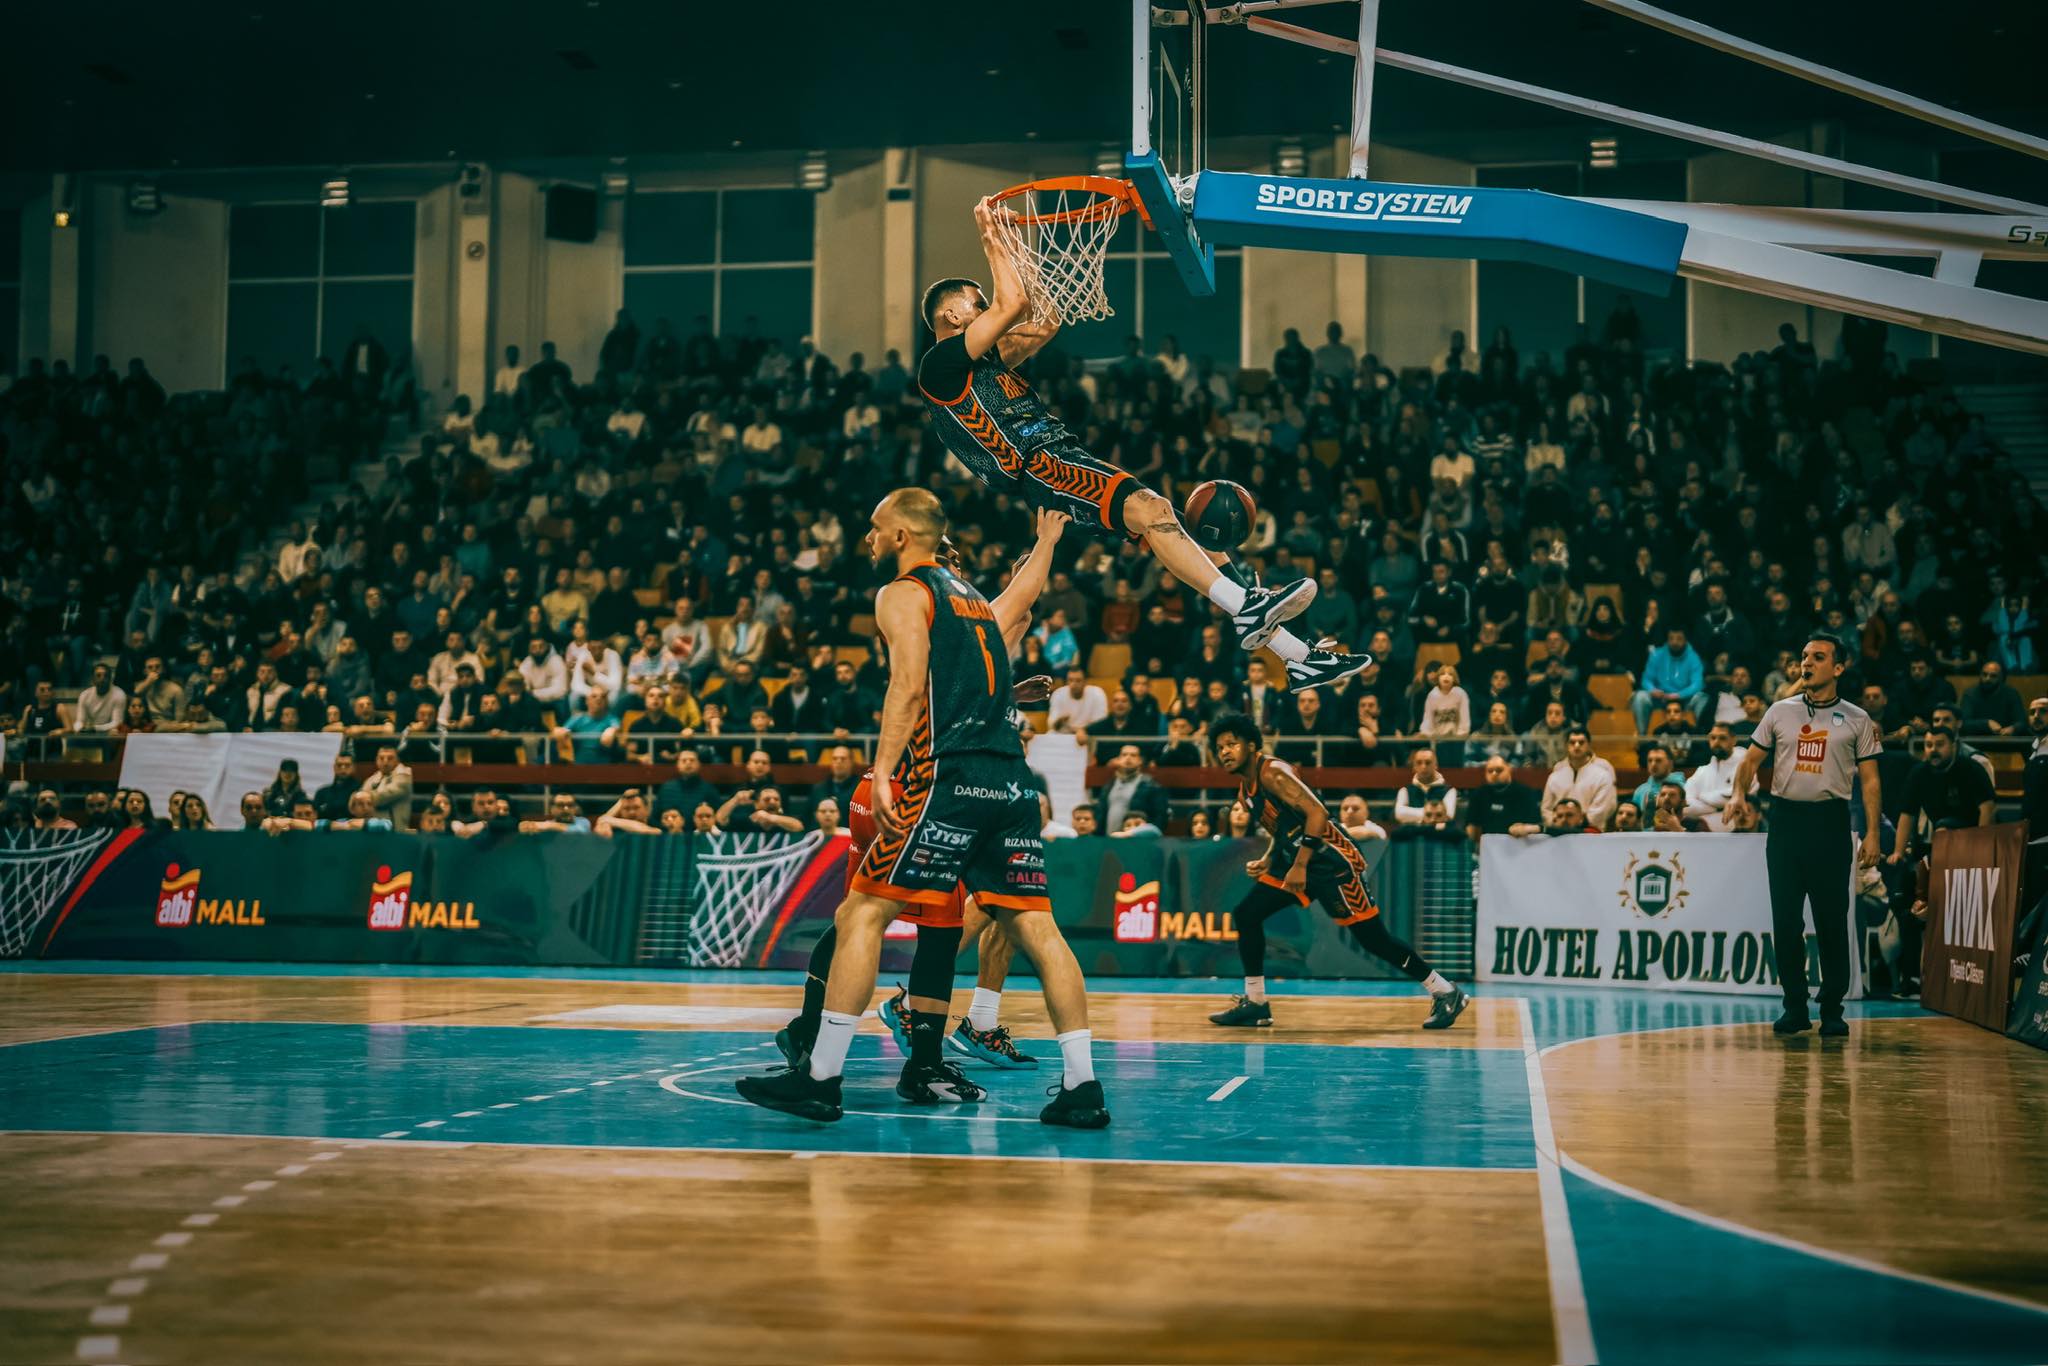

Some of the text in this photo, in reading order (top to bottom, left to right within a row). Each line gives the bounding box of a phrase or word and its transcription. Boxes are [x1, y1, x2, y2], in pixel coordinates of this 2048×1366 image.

[1257, 183, 1473, 219] SPORT SYSTEM
[1795, 762, 1824, 775] MALL
[932, 829, 973, 846] JYSK
[158, 889, 265, 926] albi MALL
[370, 891, 480, 928] albi MALL
[1944, 867, 2001, 951] VIVAX
[1159, 912, 1240, 940] MALL
[1491, 926, 1602, 979] HOTEL
